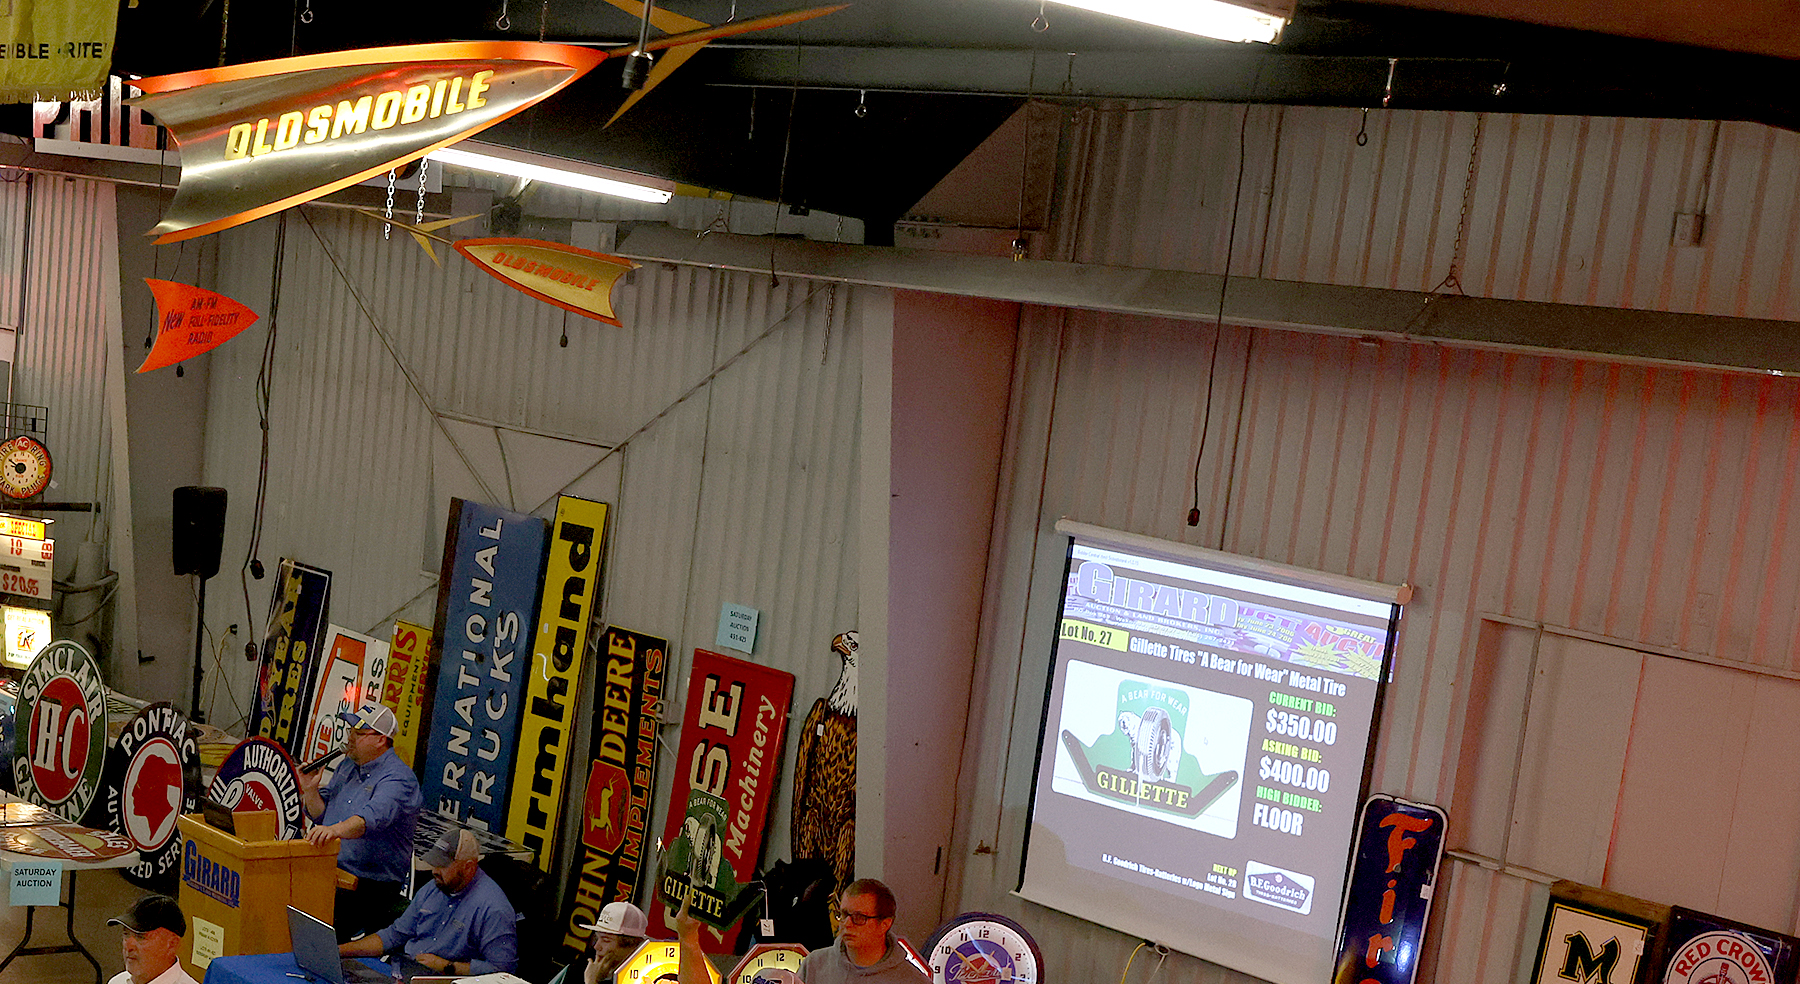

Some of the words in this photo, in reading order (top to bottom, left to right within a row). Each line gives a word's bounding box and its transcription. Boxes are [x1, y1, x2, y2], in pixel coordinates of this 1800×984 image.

[225, 70, 495, 161] OLDSMOBILE
[493, 251, 599, 293] OLDSMOBILE
[162, 308, 186, 332] New
[187, 331, 214, 346] RADIO
[16, 438, 29, 448] AC
[30, 445, 47, 467] RING
[20, 474, 46, 496] PLUGS
[1077, 560, 1240, 629] GIRARD
[729, 610, 753, 622] SATURDAY
[1060, 621, 1078, 639] Lot
[1079, 624, 1098, 643] No.
[1099, 629, 1113, 646] 27
[22, 646, 106, 726] SINCLAIR
[1128, 636, 1168, 661] Gillette
[1168, 643, 1197, 666] Tires
[1208, 653, 1237, 675] Bear
[1235, 658, 1254, 678] for
[1288, 669, 1322, 692] Metal
[1322, 675, 1348, 697] Tire
[1127, 689, 1148, 700] BEAR
[1167, 695, 1189, 716] WEAR
[1268, 691, 1312, 713] CURRENT
[1313, 700, 1337, 718] BID:
[121, 708, 197, 766] PONTIAC
[1265, 706, 1338, 747] $350.00
[616, 646, 664, 872] IMPLEMENTS
[1261, 738, 1299, 760] ASKING
[1300, 746, 1323, 764] BID:
[243, 747, 300, 829] AUTHORIZED
[561, 844, 612, 952] JOHN
[600, 630, 637, 766] DEERE
[724, 693, 779, 861] Machinery
[1095, 770, 1191, 811] GILLETTE
[1258, 755, 1331, 794] $400.00
[1256, 785, 1282, 804] HIGH
[1283, 792, 1324, 813] BIDDER:
[1252, 802, 1305, 837] FLOOR
[14, 867, 57, 878] SATURDAY
[16, 879, 53, 888] AUCTION
[182, 838, 242, 900] GIRARD
[1674, 940, 1715, 980] RED
